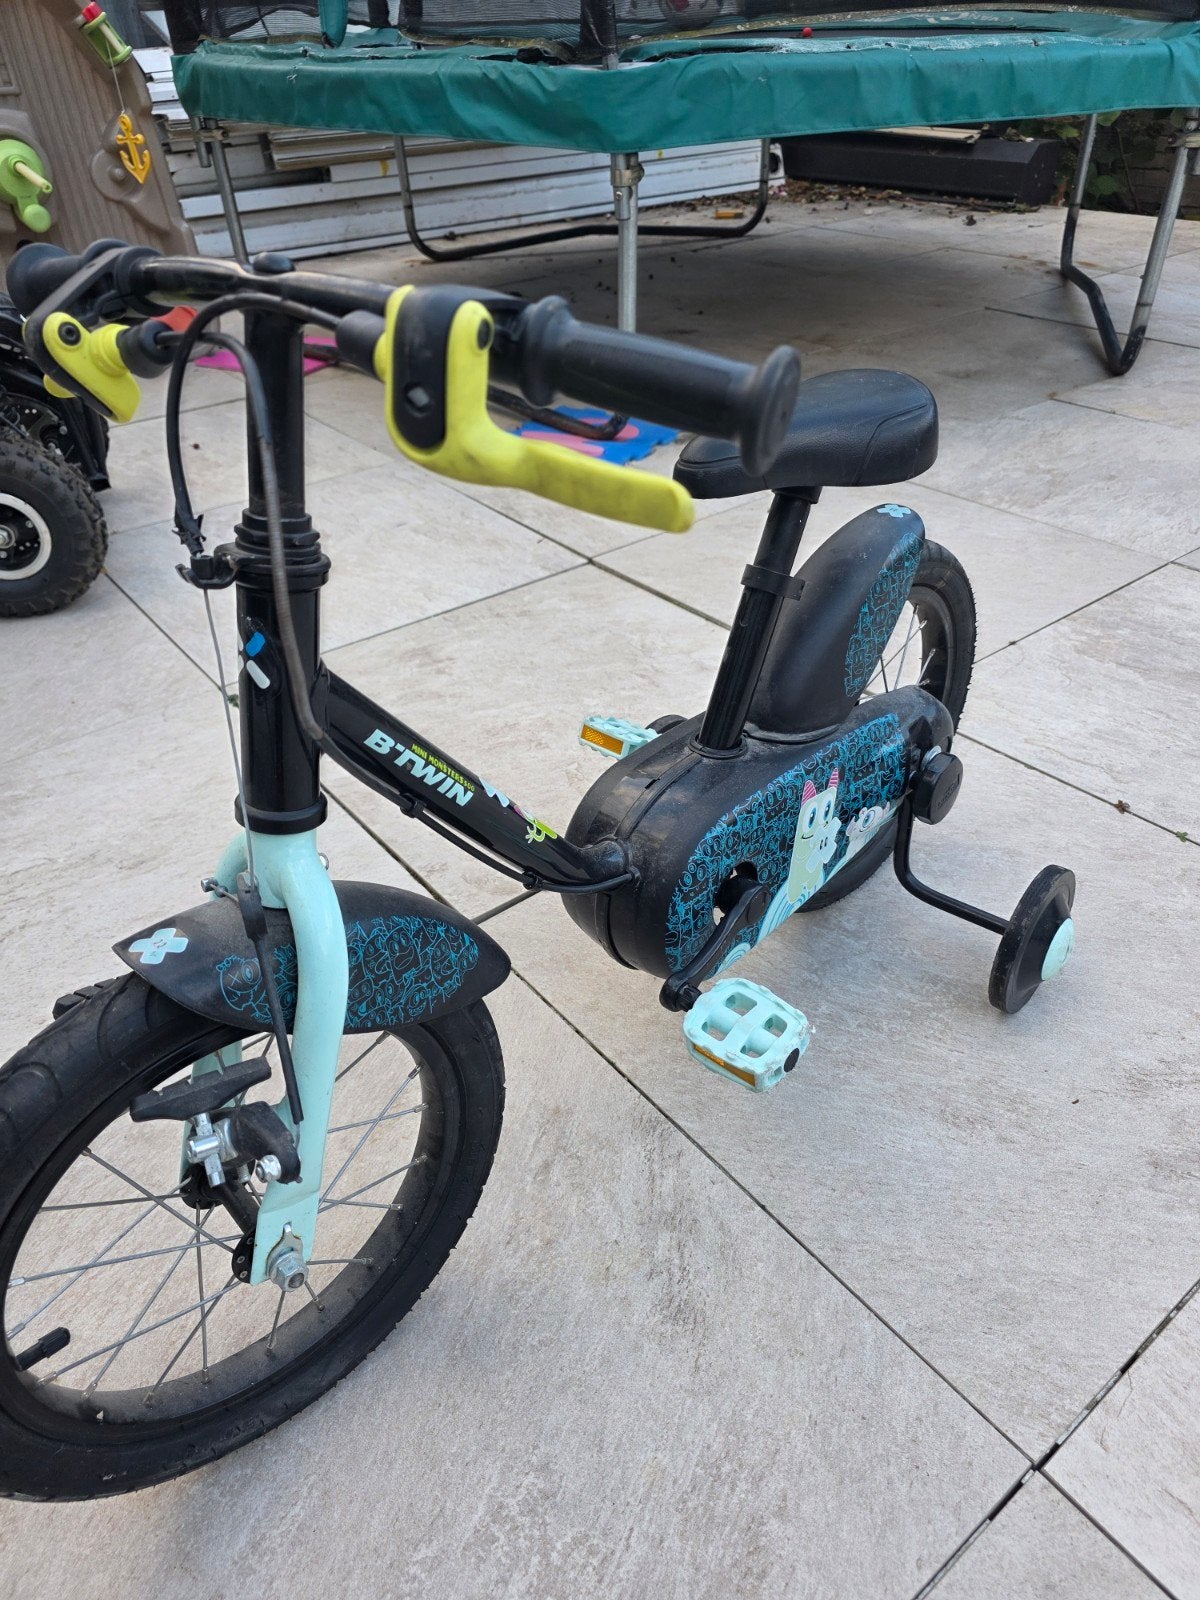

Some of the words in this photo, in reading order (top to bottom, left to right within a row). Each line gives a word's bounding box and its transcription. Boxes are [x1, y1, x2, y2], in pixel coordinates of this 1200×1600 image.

[364, 729, 474, 806] B'TWIN
[411, 743, 428, 759] MINI
[428, 755, 464, 784] MONSTERS
